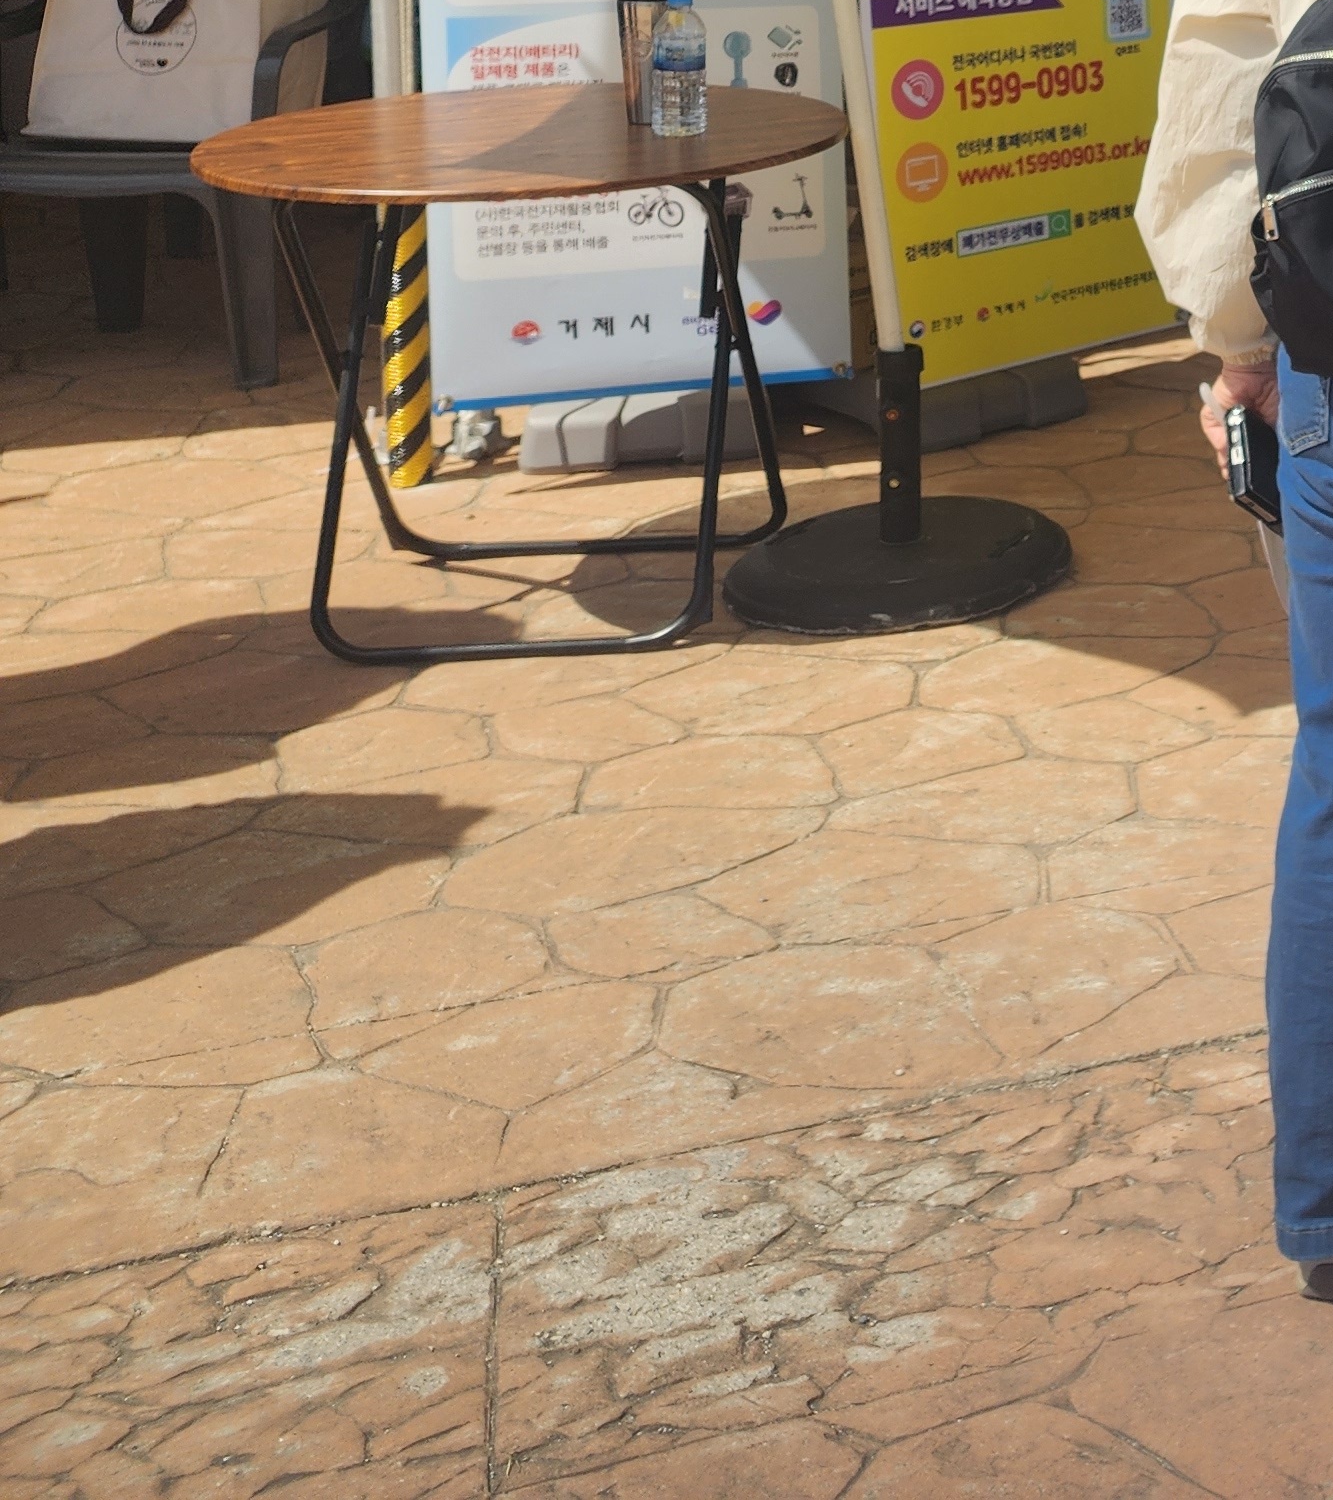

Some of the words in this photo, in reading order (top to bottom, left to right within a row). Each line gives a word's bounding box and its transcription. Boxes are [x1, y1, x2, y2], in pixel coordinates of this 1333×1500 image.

[951, 46, 1027, 73] 전국어디서나
[1028, 38, 1079, 63] 국번없이
[953, 59, 1105, 113] 1599-0903
[955, 136, 994, 160] 인터넷
[995, 128, 1057, 154] 홈페이지에
[1050, 269, 1159, 305] 한국전자제품자원순환공제조
